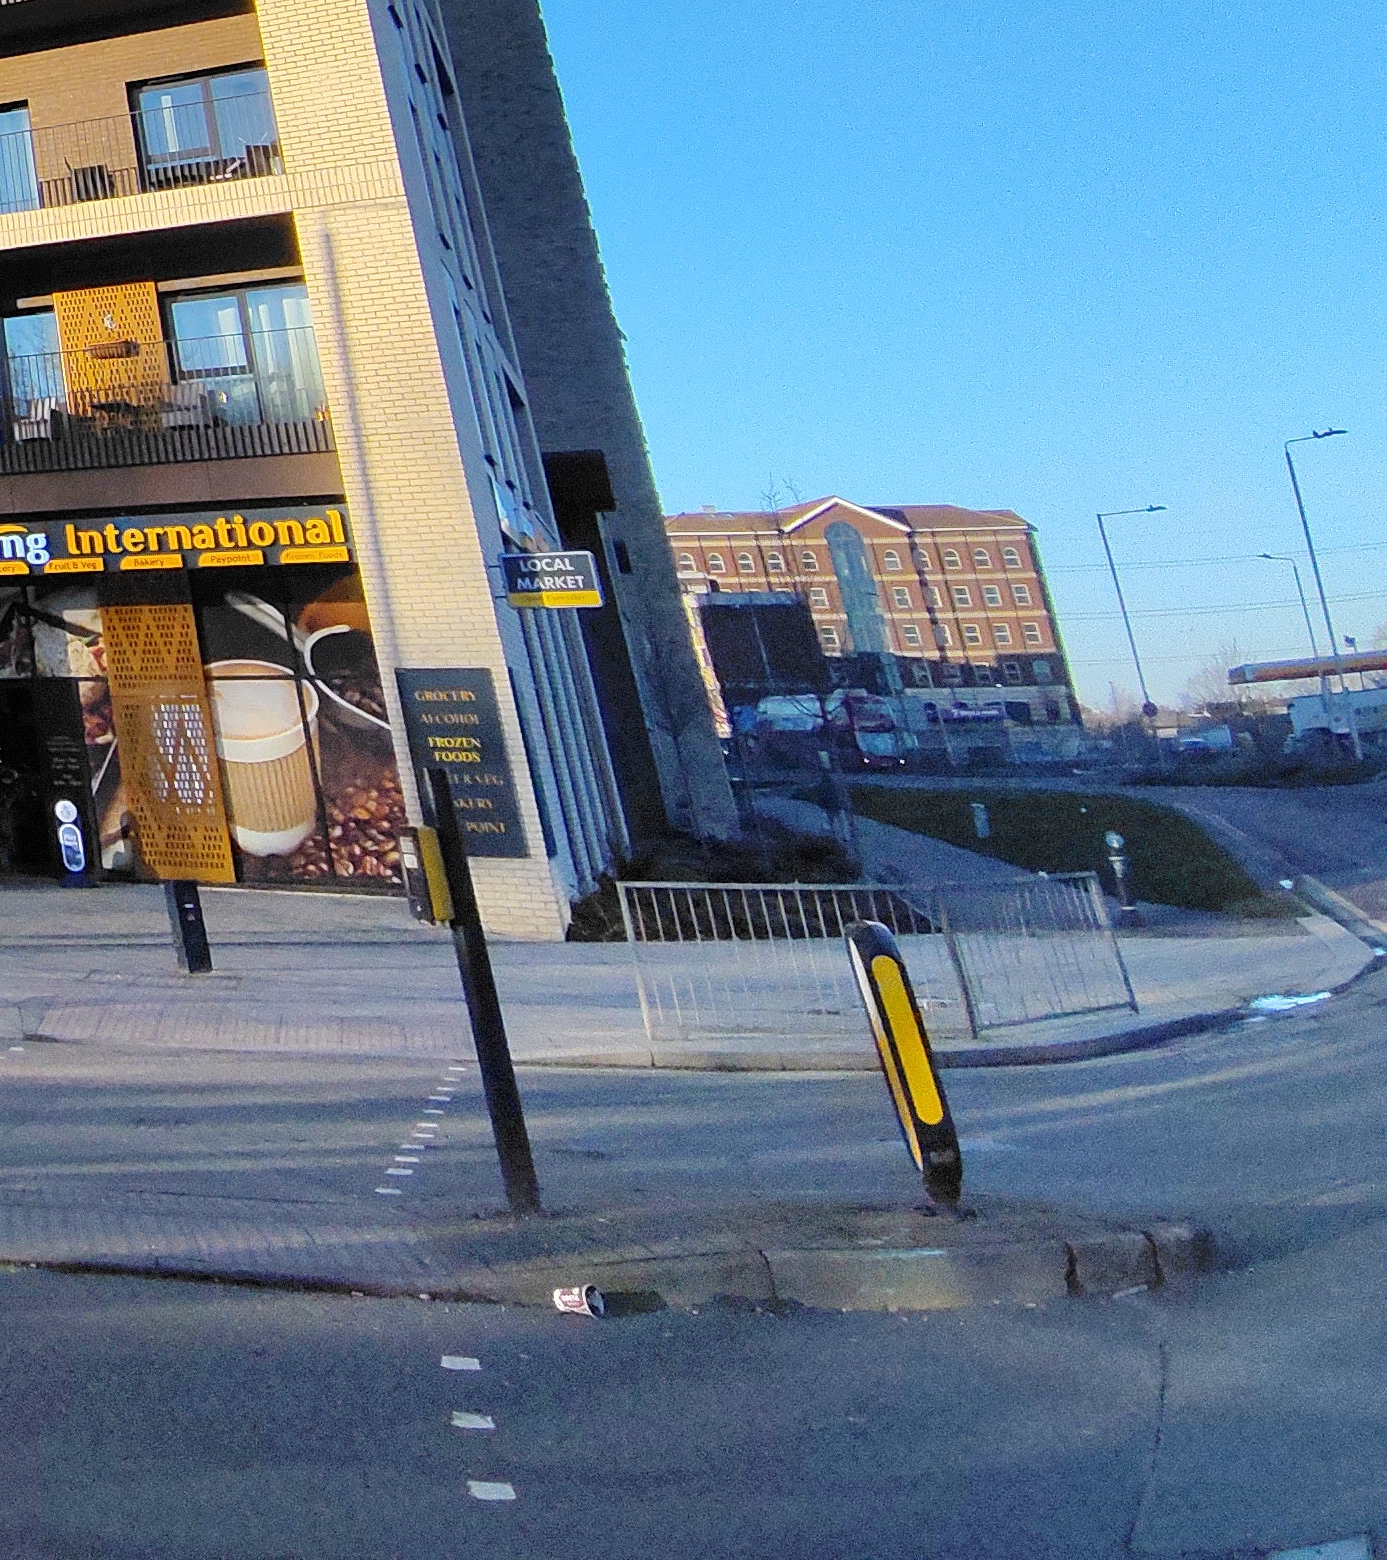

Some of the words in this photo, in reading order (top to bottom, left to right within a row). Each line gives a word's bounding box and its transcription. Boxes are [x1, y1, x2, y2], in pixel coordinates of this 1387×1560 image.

[64, 508, 346, 556] International
[133, 557, 165, 568] Bakery
[210, 553, 252, 564] Paypoint
[518, 557, 575, 572] LOCAL
[81, 560, 97, 571] Veg
[516, 575, 585, 590] MARKET
[413, 690, 477, 702] GROCERY
[420, 713, 479, 725] ALCOHOL
[427, 736, 482, 748] FROZEN
[433, 751, 482, 763] FOODS
[475, 774, 504, 786] VEG
[452, 798, 494, 809] AKERY
[465, 821, 508, 833] POINT
